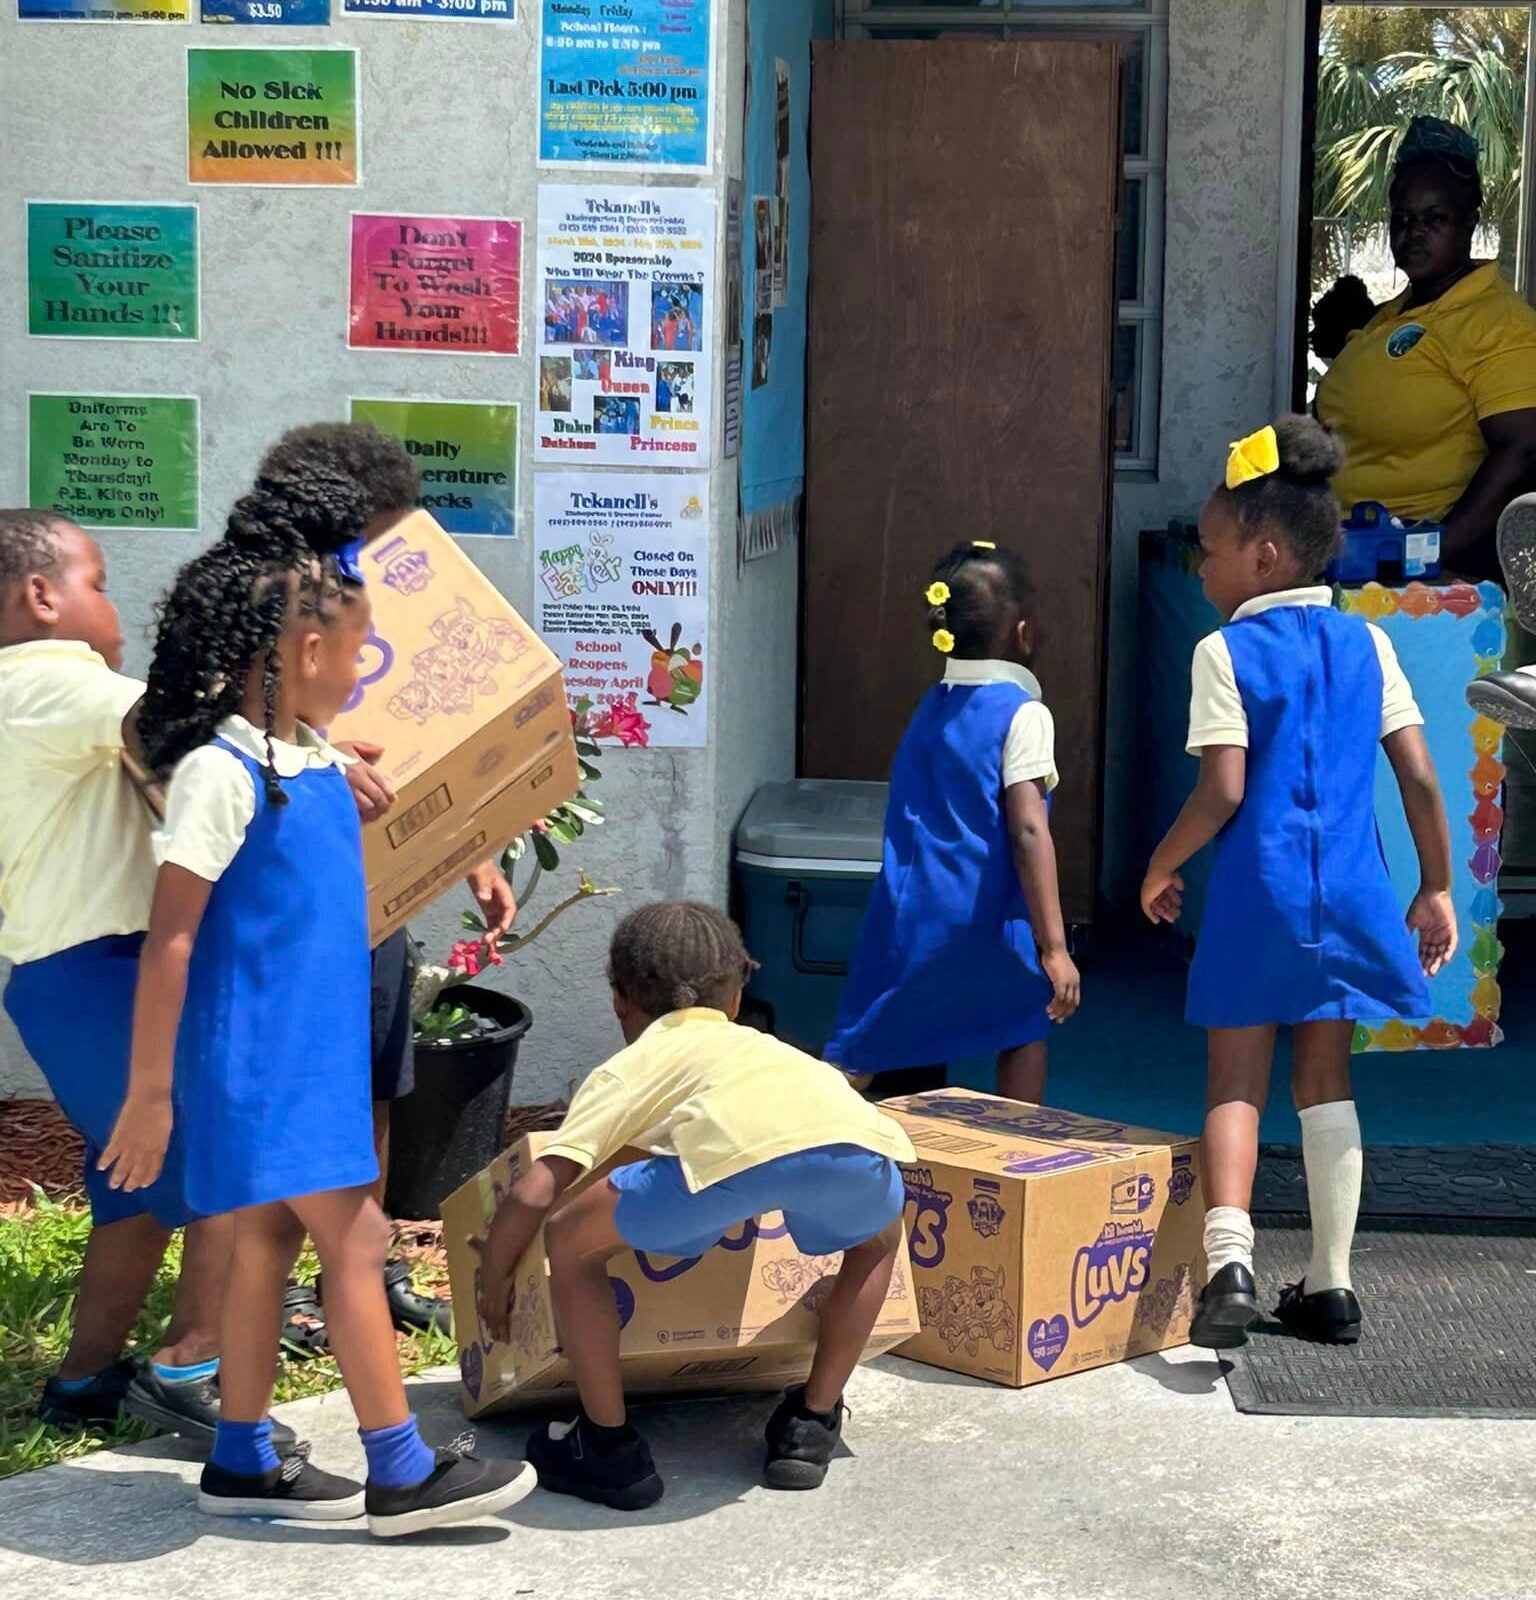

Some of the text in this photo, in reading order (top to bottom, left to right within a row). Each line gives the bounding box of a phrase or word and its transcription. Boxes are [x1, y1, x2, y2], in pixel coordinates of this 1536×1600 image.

[600, 5, 633, 19] Friday
[560, 22, 601, 33] School
[604, 22, 640, 34] Hours
[220, 80, 324, 101] No Sick
[548, 79, 697, 103] Last Pick 5:00 pm
[214, 110, 329, 130] Children
[201, 140, 343, 161] Allowed !!!
[64, 217, 161, 241] Please
[399, 225, 468, 247] Don't
[53, 245, 175, 270] Sanitize
[390, 248, 474, 278] Forget
[605, 253, 673, 268] Sponsorship
[546, 266, 570, 277] Who
[572, 267, 593, 278] Will
[628, 270, 648, 281] The
[652, 270, 695, 282] Crowns
[75, 272, 150, 296] Your
[373, 272, 492, 296] To Wash
[45, 300, 144, 324] Hands
[400, 297, 465, 320] Your
[376, 321, 488, 345] Hands!!!
[614, 351, 655, 372] King
[600, 379, 650, 393] Queen
[68, 401, 148, 416] Uniforms
[80, 420, 137, 432] Are To
[553, 419, 592, 433] Duke
[650, 416, 699, 430] Prince
[72, 436, 145, 450] Be Worn
[405, 440, 461, 461] Daily
[630, 436, 697, 452] Princess
[63, 453, 130, 469] Monday
[65, 469, 152, 487] Thursday!
[422, 468, 507, 484] erature
[58, 486, 92, 501] P.E.
[98, 488, 133, 501] Kits
[570, 492, 658, 509] Tekanell's
[121, 506, 165, 522] Only!
[540, 544, 584, 567] Happy
[634, 550, 694, 562] Closed On
[630, 566, 697, 579] These Days
[632, 581, 697, 597] ONLY!!!
[575, 641, 622, 653] School
[569, 658, 628, 672] Reopens
[611, 678, 643, 688] April
[1075, 1246, 1148, 1321] Luvs
